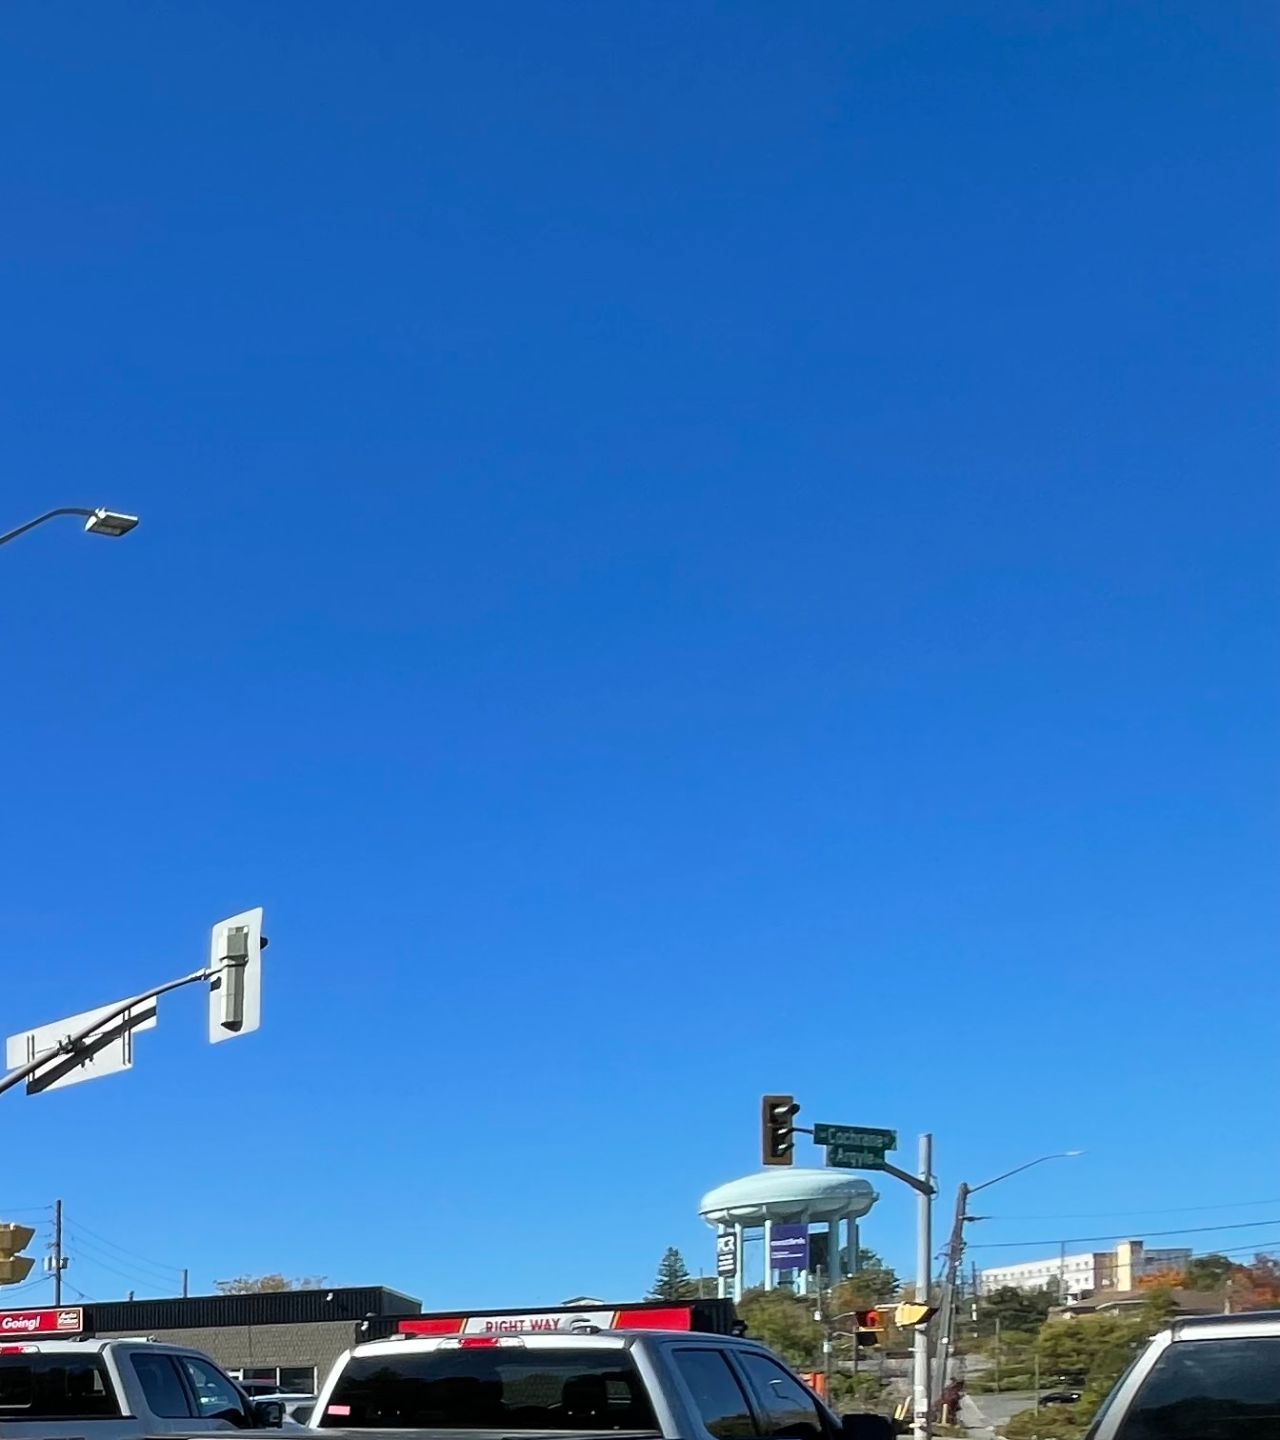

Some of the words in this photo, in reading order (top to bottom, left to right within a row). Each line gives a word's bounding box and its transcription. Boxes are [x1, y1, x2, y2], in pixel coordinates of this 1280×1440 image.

[2, 1315, 40, 1332] Going!
[485, 1319, 526, 1333] RIGHT
[529, 1317, 561, 1331] WAY
